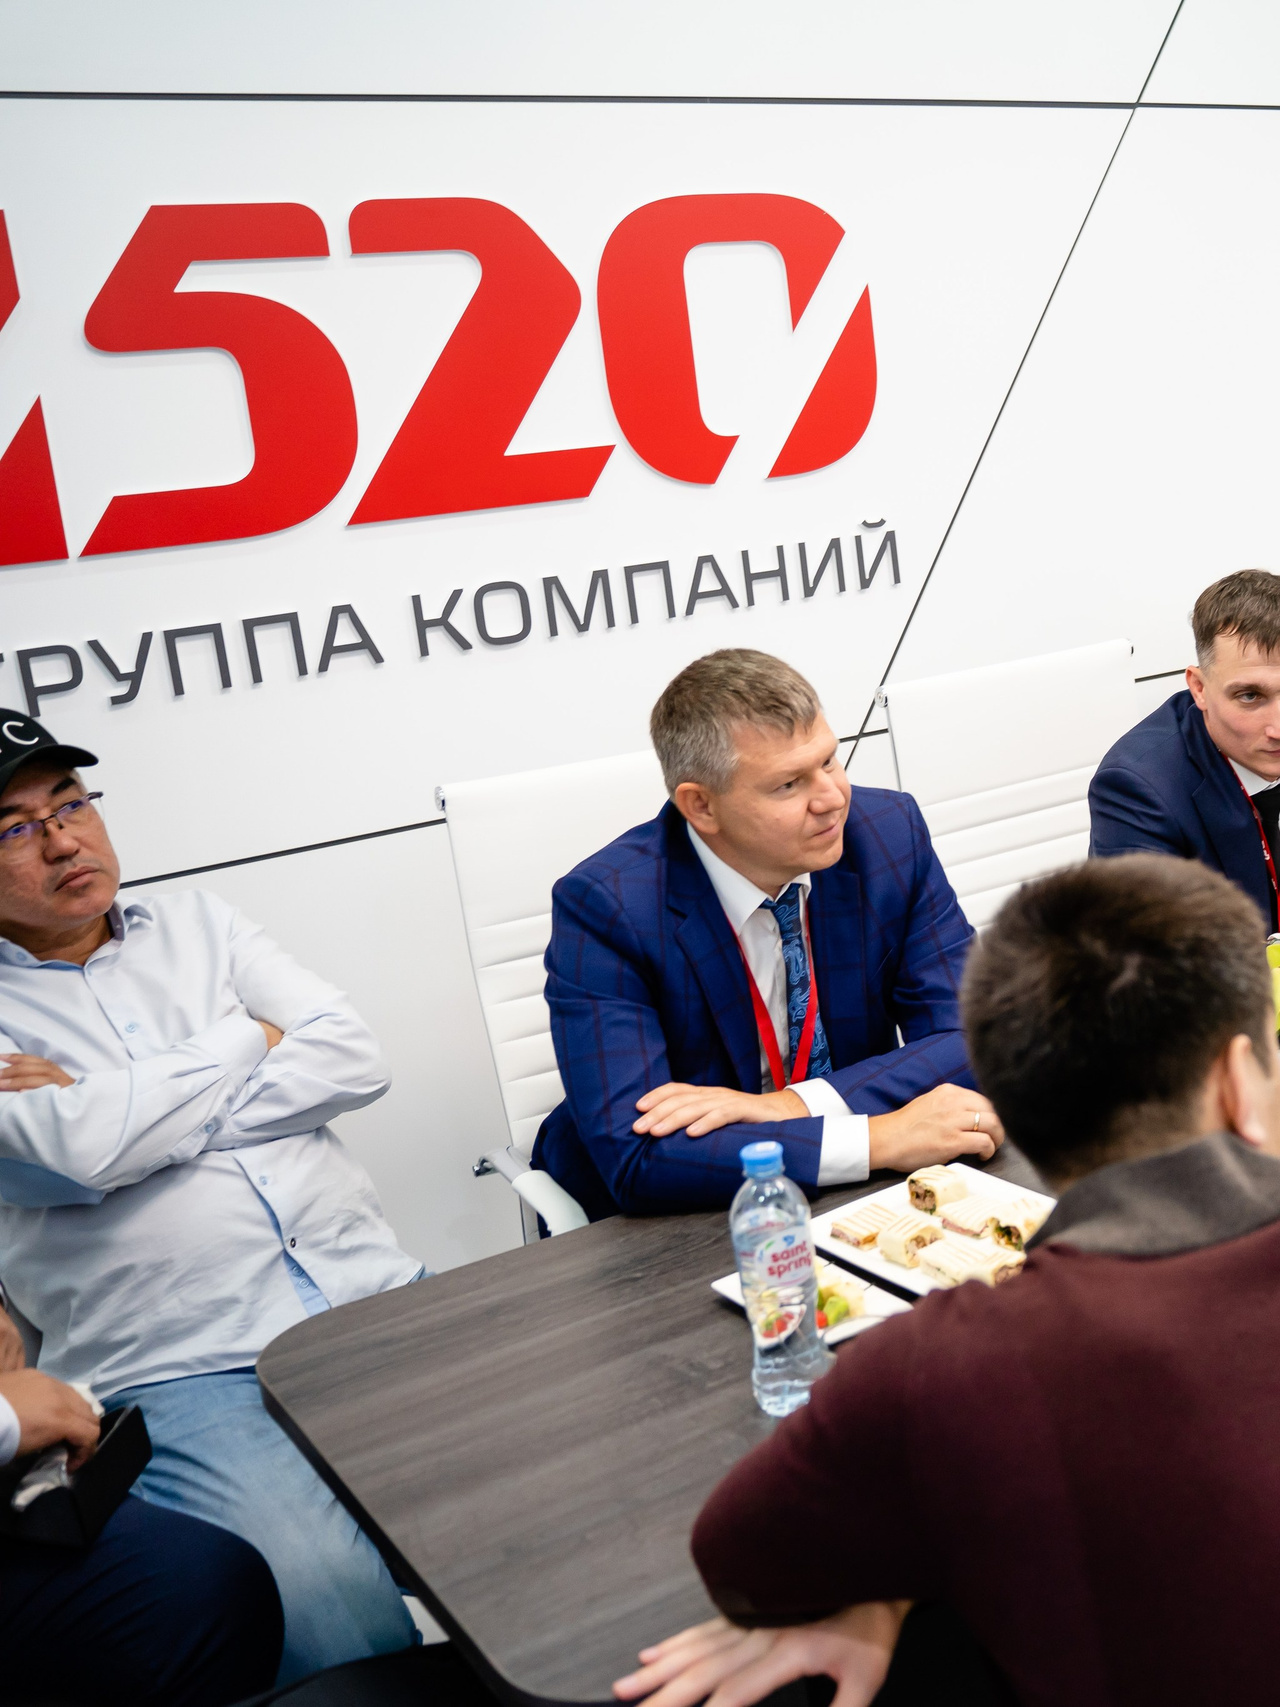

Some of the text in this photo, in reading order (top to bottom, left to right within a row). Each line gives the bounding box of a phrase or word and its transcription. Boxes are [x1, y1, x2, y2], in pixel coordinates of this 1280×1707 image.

[0, 194, 877, 566] 520
[0, 519, 901, 718] РУППА КОМПАНИЙ
